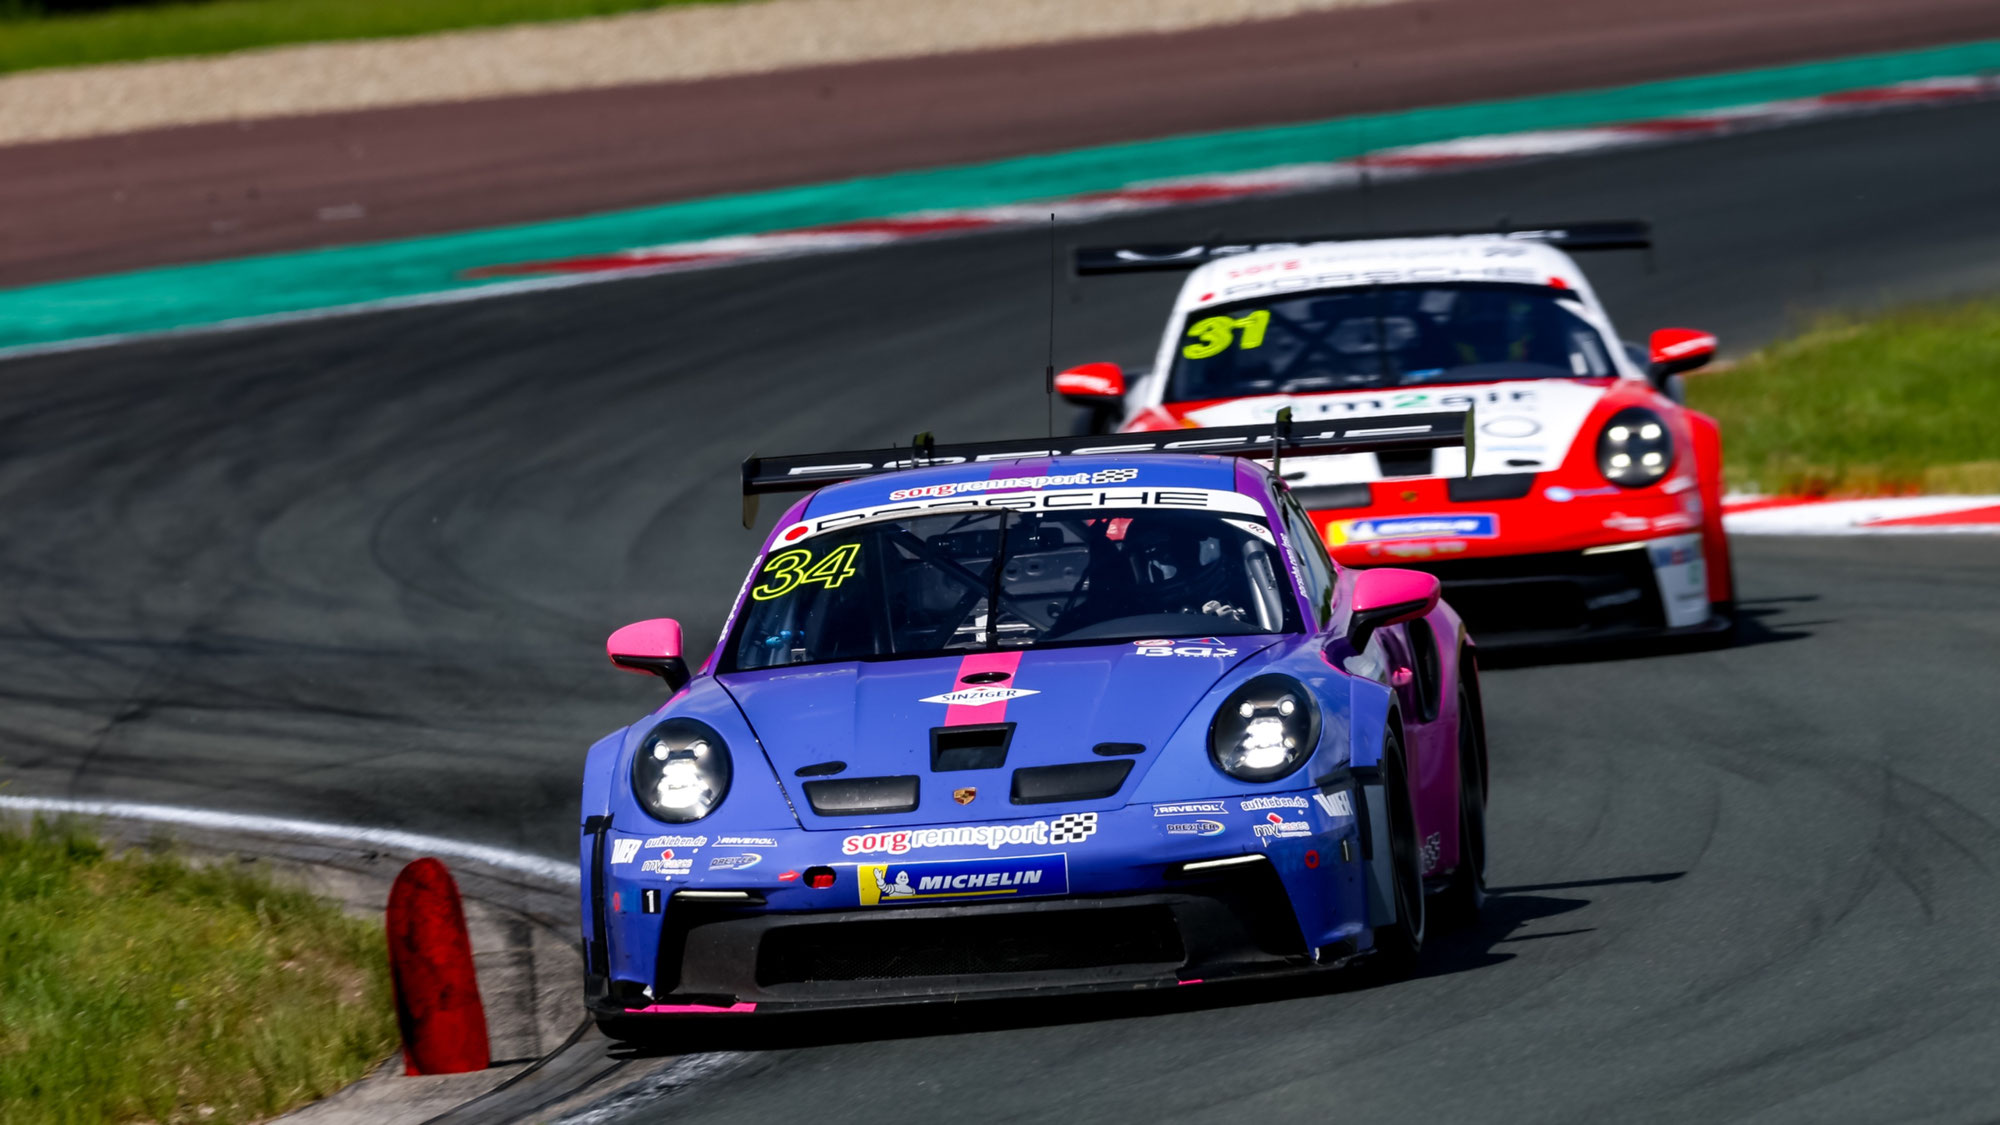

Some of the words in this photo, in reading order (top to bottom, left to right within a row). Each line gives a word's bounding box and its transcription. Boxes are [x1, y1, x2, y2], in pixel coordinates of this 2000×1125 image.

[1182, 309, 1271, 360] 31
[752, 543, 861, 601] 34
[941, 690, 1018, 702] SINZIGER
[1158, 804, 1220, 813] RAVENOL
[720, 837, 776, 845] RAVENOL
[917, 870, 1043, 891] MICHELIN
[646, 889, 655, 913] 1
